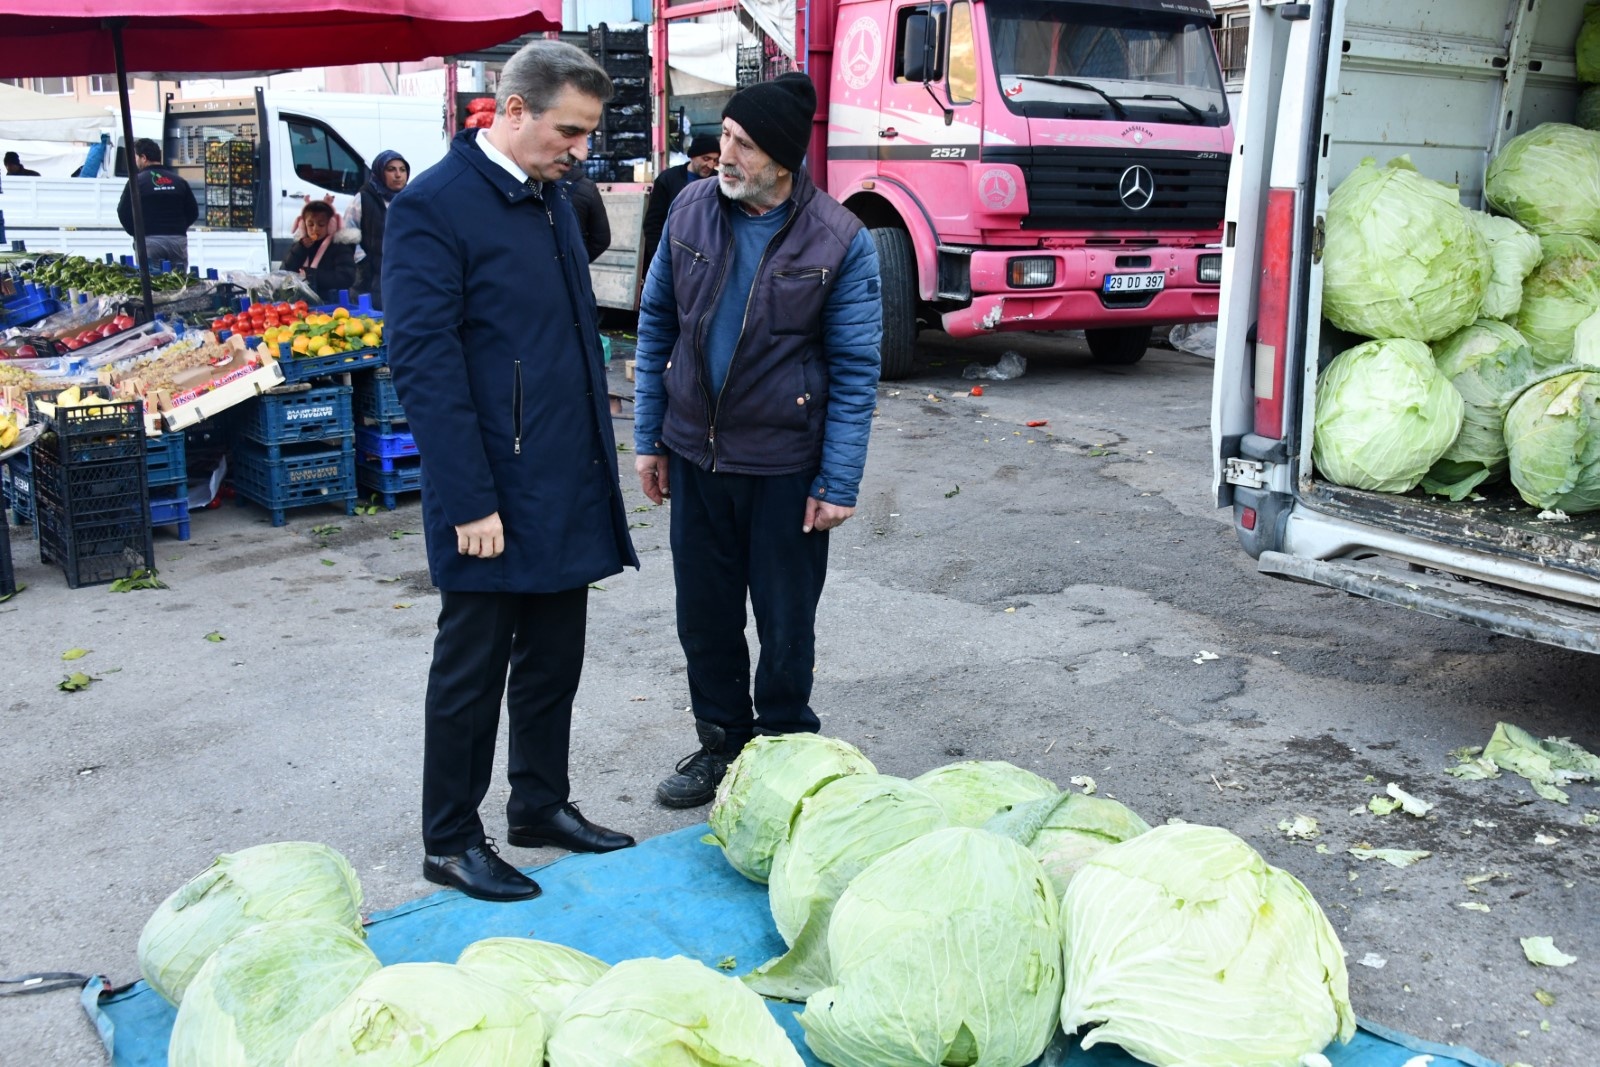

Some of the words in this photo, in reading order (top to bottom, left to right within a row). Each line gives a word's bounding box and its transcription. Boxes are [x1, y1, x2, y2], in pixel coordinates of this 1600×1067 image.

[931, 147, 967, 158] 2521
[1111, 277, 1123, 289] 29
[1127, 276, 1141, 288] DD
[1146, 275, 1163, 288] 397
[287, 410, 333, 420] BAYRAKLAR
